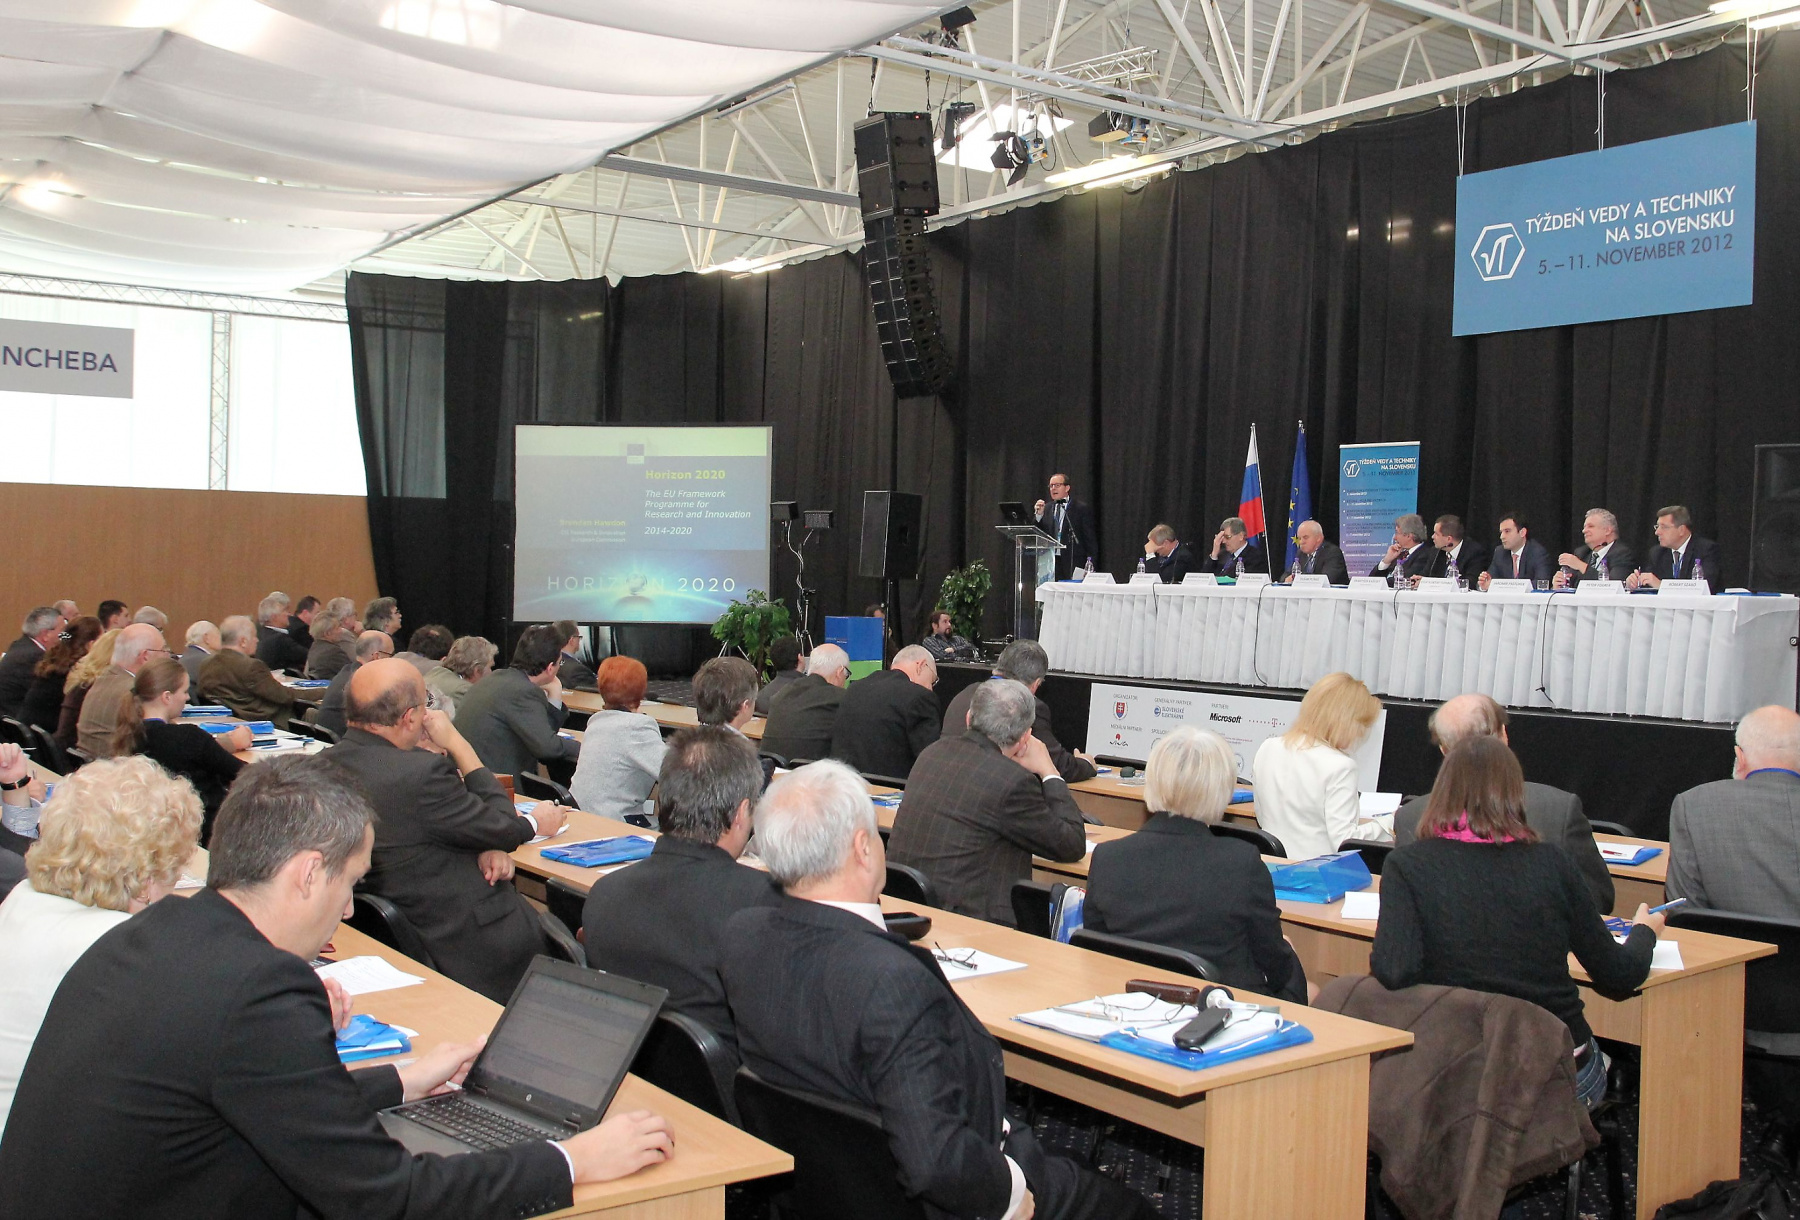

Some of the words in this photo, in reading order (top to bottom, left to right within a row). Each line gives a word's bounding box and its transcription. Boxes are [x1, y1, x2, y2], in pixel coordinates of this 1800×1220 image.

[1526, 207, 1585, 234] TÝŽDEŇ
[1589, 203, 1631, 224] VEDY
[1634, 201, 1647, 218] A
[1650, 185, 1736, 215] TECHNIKY
[1605, 226, 1631, 244] NA
[1634, 209, 1735, 240] SLOVENSKU
[1596, 240, 1686, 267] NOVEMBER
[1691, 233, 1734, 254] 2012
[2, 345, 118, 373] NCHEBA
[645, 470, 692, 480] Horizon
[695, 470, 726, 480] 2020
[645, 489, 661, 498] The
[663, 489, 676, 498] EU
[677, 489, 726, 498] Framework
[644, 500, 695, 509] Programme
[696, 500, 710, 509] for
[644, 510, 684, 519] Research
[685, 510, 703, 519] and
[704, 510, 751, 519] Innovation
[644, 526, 693, 535] 2014-2020
[677, 577, 736, 592] 2020
[1209, 712, 1243, 724] Microsoft
